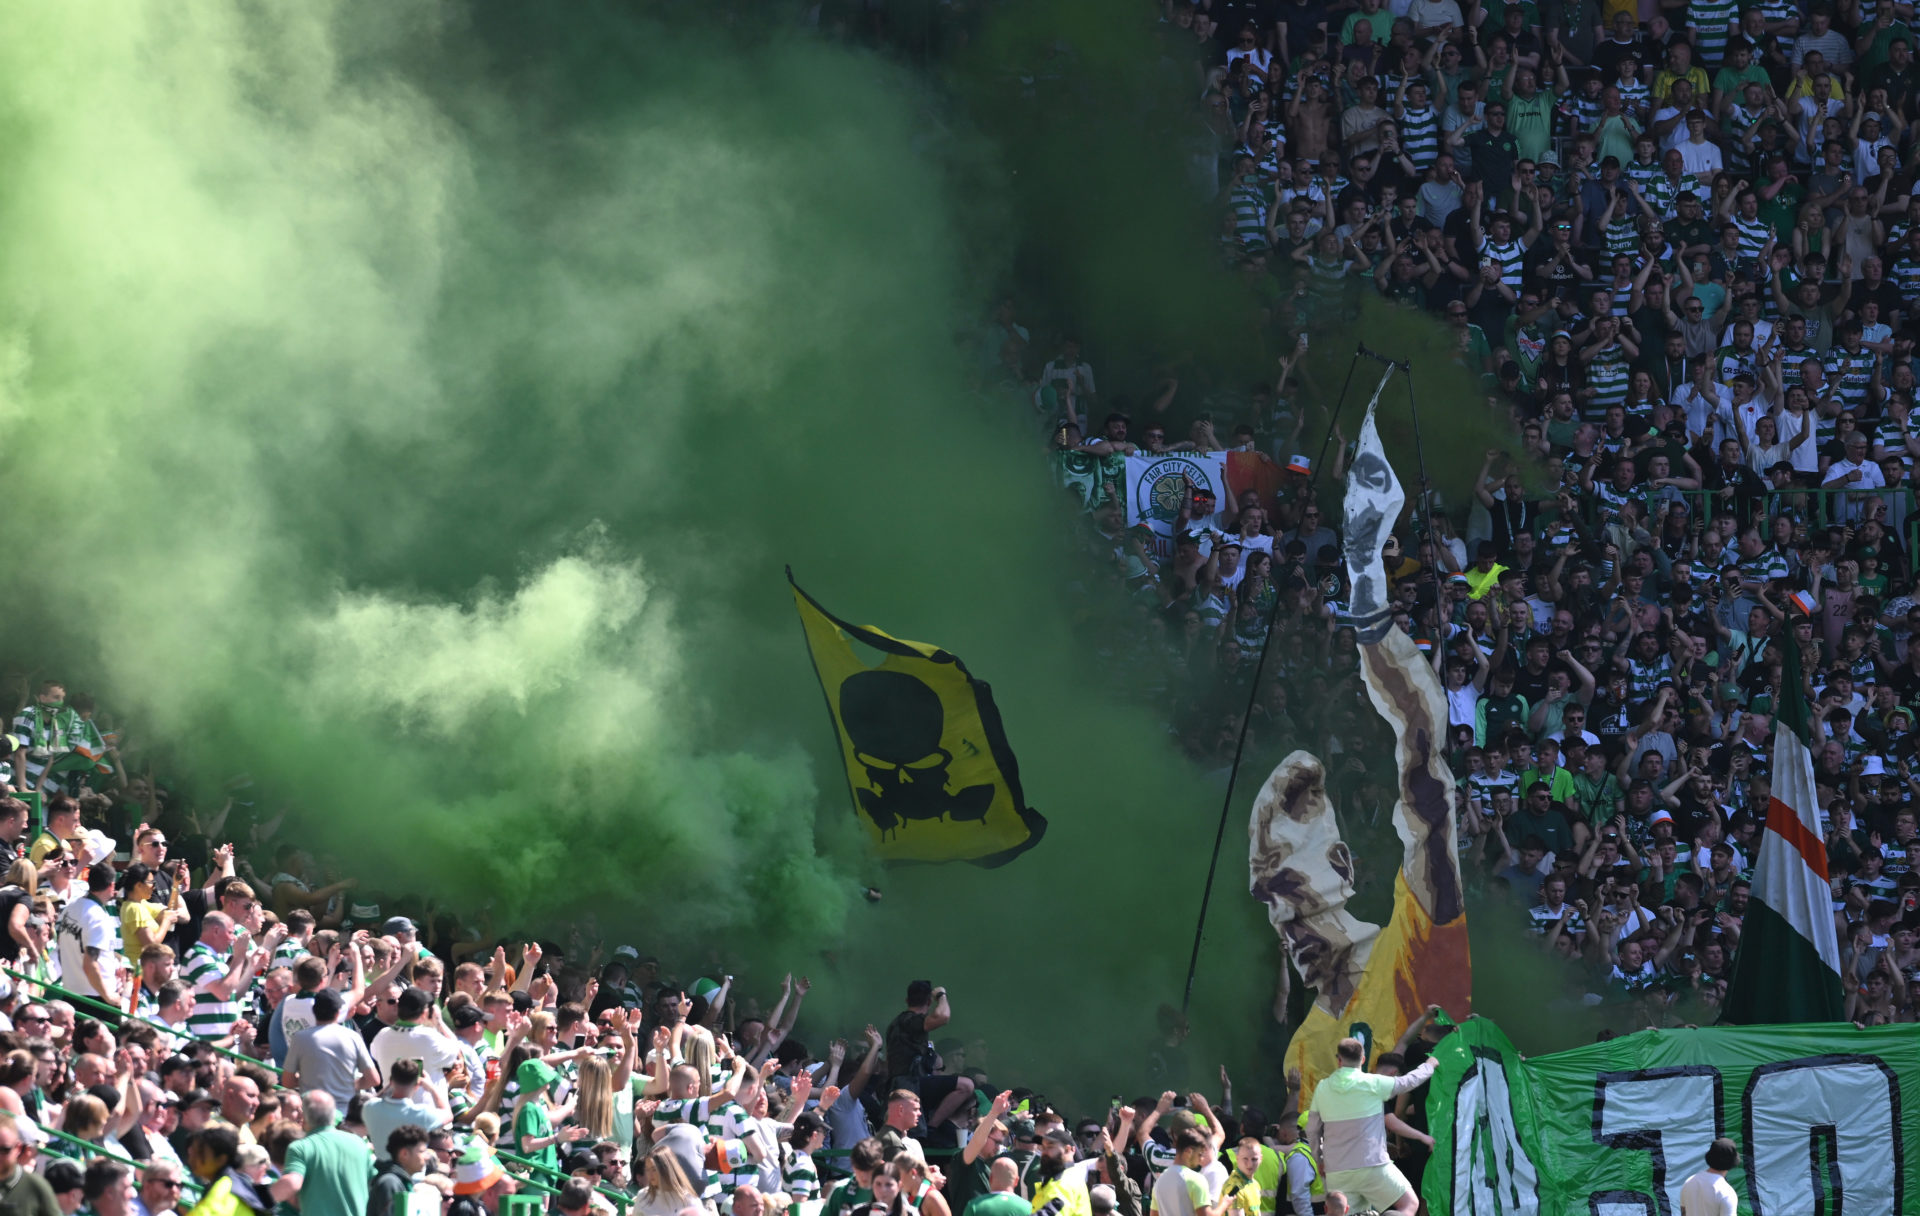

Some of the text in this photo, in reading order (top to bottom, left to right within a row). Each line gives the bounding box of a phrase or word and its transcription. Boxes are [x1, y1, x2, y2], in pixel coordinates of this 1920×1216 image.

[1144, 462, 1206, 486] FAIR CITY CELTS
[1832, 604, 1848, 617] 22
